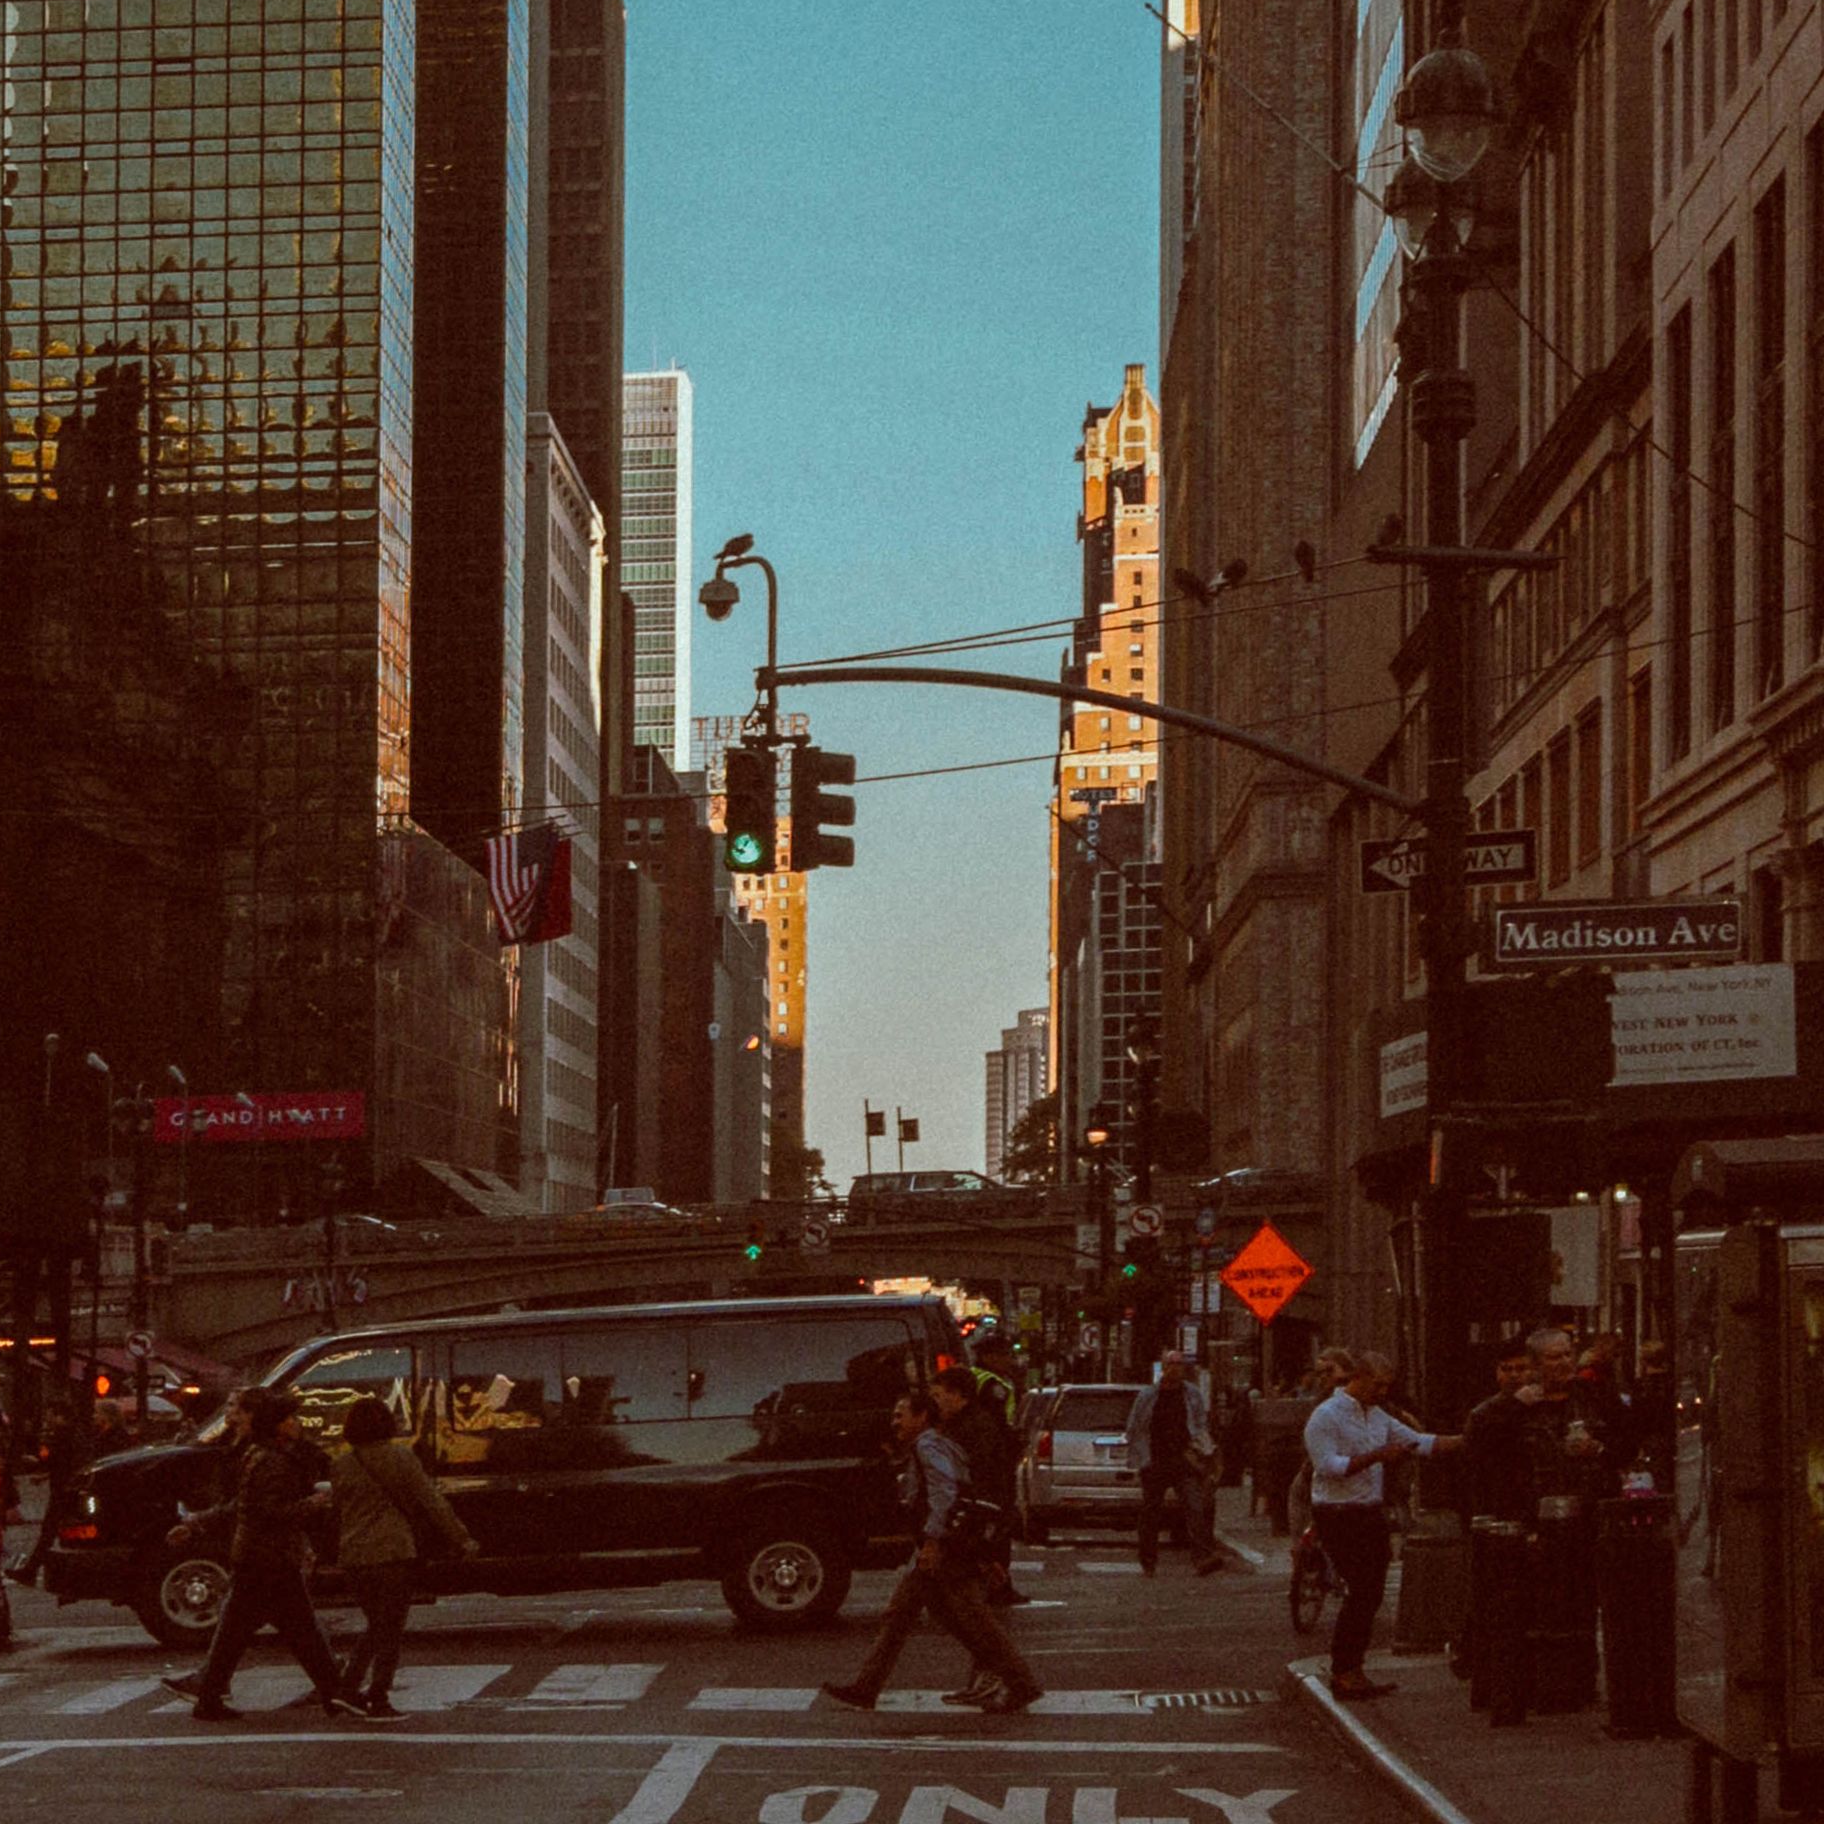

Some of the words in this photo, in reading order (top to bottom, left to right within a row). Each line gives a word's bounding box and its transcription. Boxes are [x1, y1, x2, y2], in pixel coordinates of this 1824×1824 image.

[691, 713, 810, 741] TUR
[1388, 854, 1422, 876] ON
[1502, 921, 1658, 950] Madison
[1668, 916, 1737, 944] Ave
[1654, 1016, 1689, 1029] NEW
[1696, 1013, 1738, 1027] YORK
[1618, 1041, 1685, 1055] ORATION
[1691, 1039, 1710, 1052] OF
[169, 1110, 254, 1126] GAND
[758, 1786, 1300, 1824] ONLY
